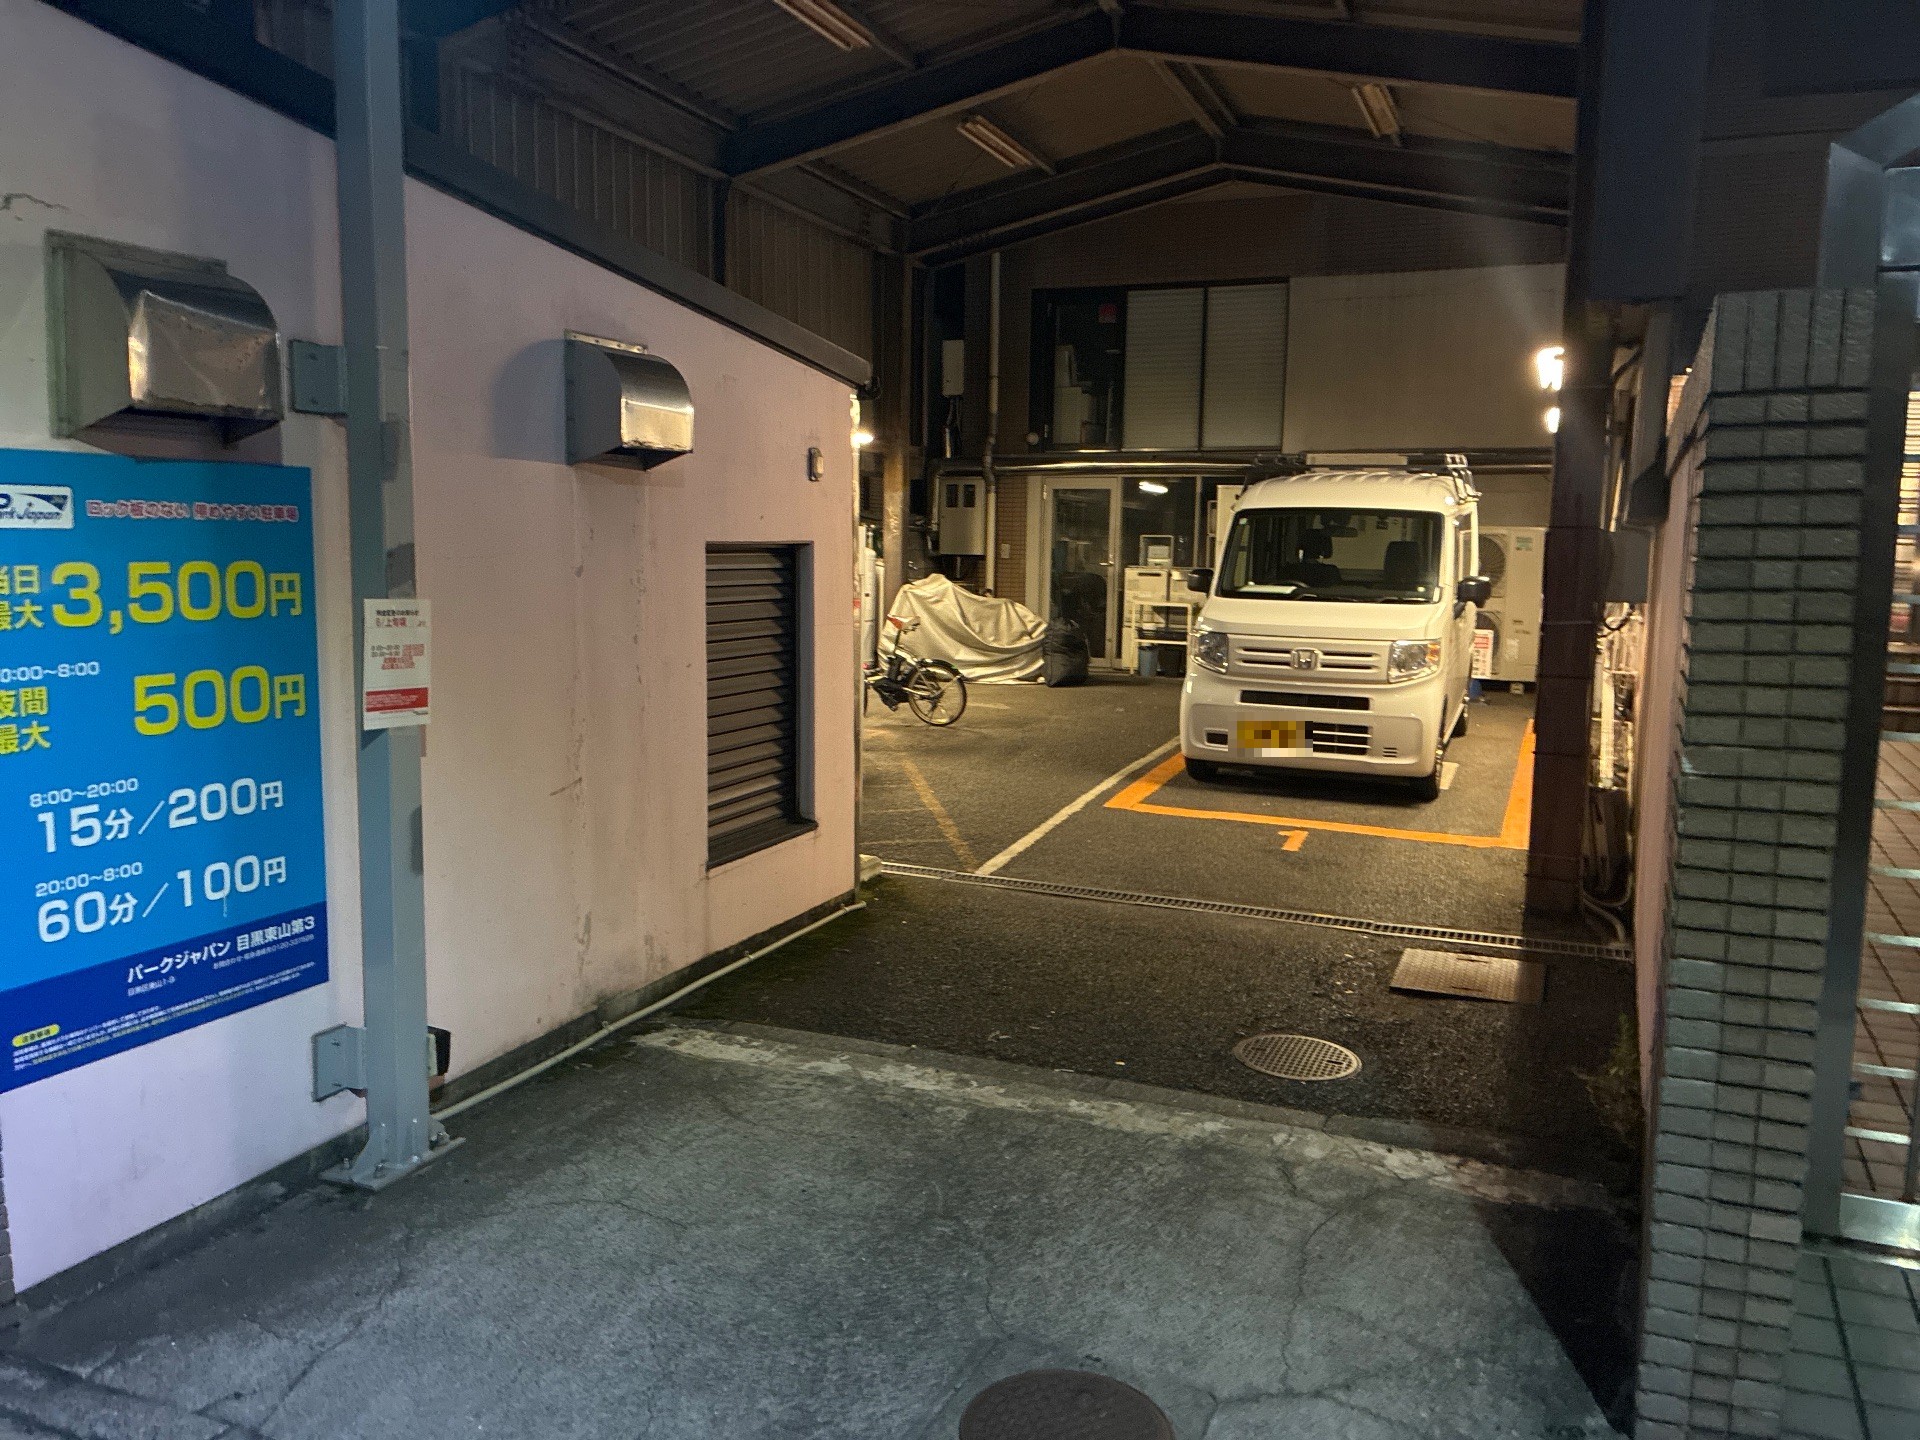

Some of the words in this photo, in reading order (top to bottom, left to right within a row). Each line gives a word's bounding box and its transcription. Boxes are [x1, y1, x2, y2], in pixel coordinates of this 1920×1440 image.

[51, 560, 303, 635] 3,500円
[0, 661, 100, 683] 0:00~8:00
[133, 665, 307, 736] 500円
[1278, 829, 1310, 852] 1
